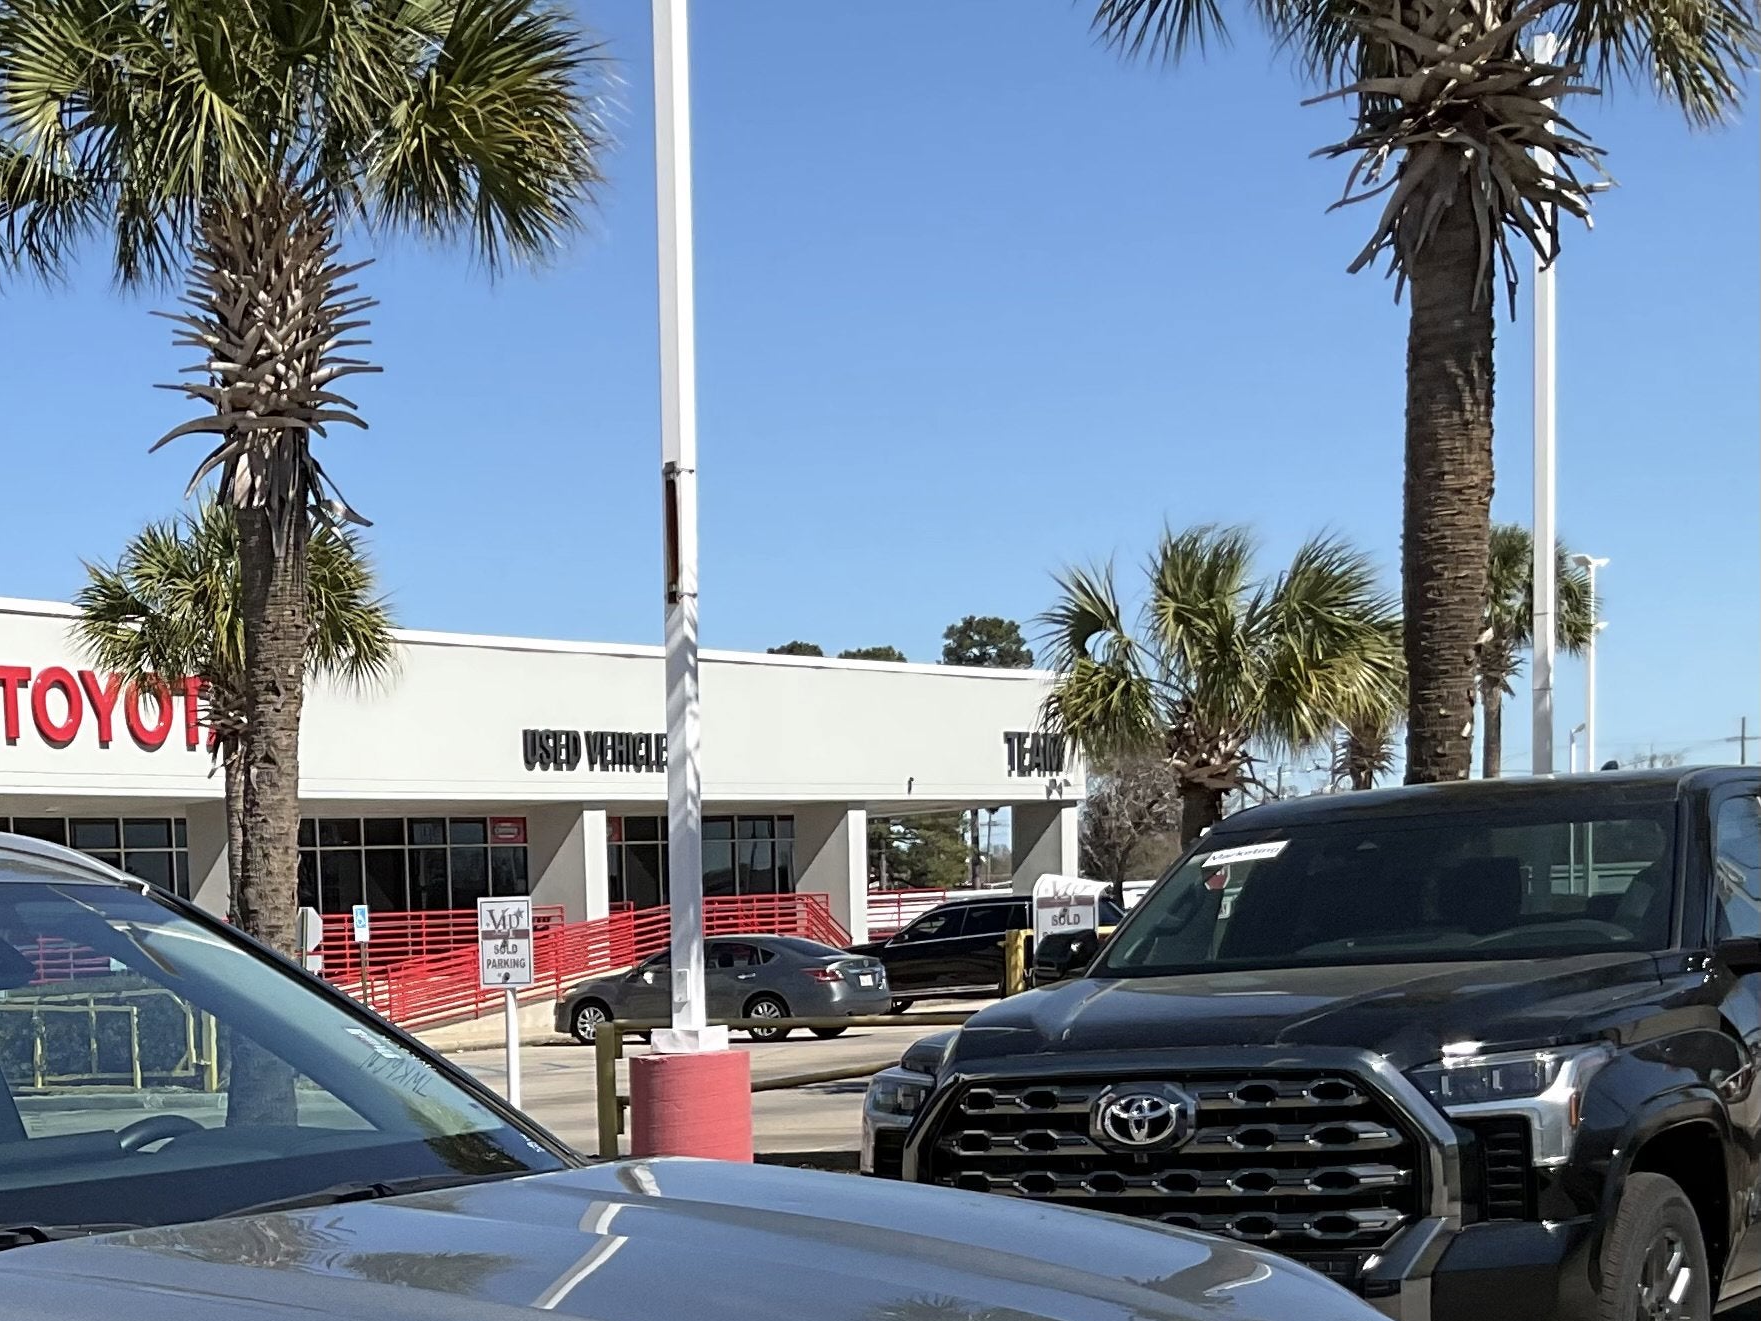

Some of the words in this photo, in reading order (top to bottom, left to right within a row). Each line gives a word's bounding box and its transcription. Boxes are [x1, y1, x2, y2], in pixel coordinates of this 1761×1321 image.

[522, 729, 582, 771] USED
[584, 731, 670, 773] VEHICLE
[1003, 731, 1066, 777] TEAM
[1050, 913, 1081, 927] SOLD
[493, 943, 519, 955] SOLD
[486, 958, 527, 970] PARKING
